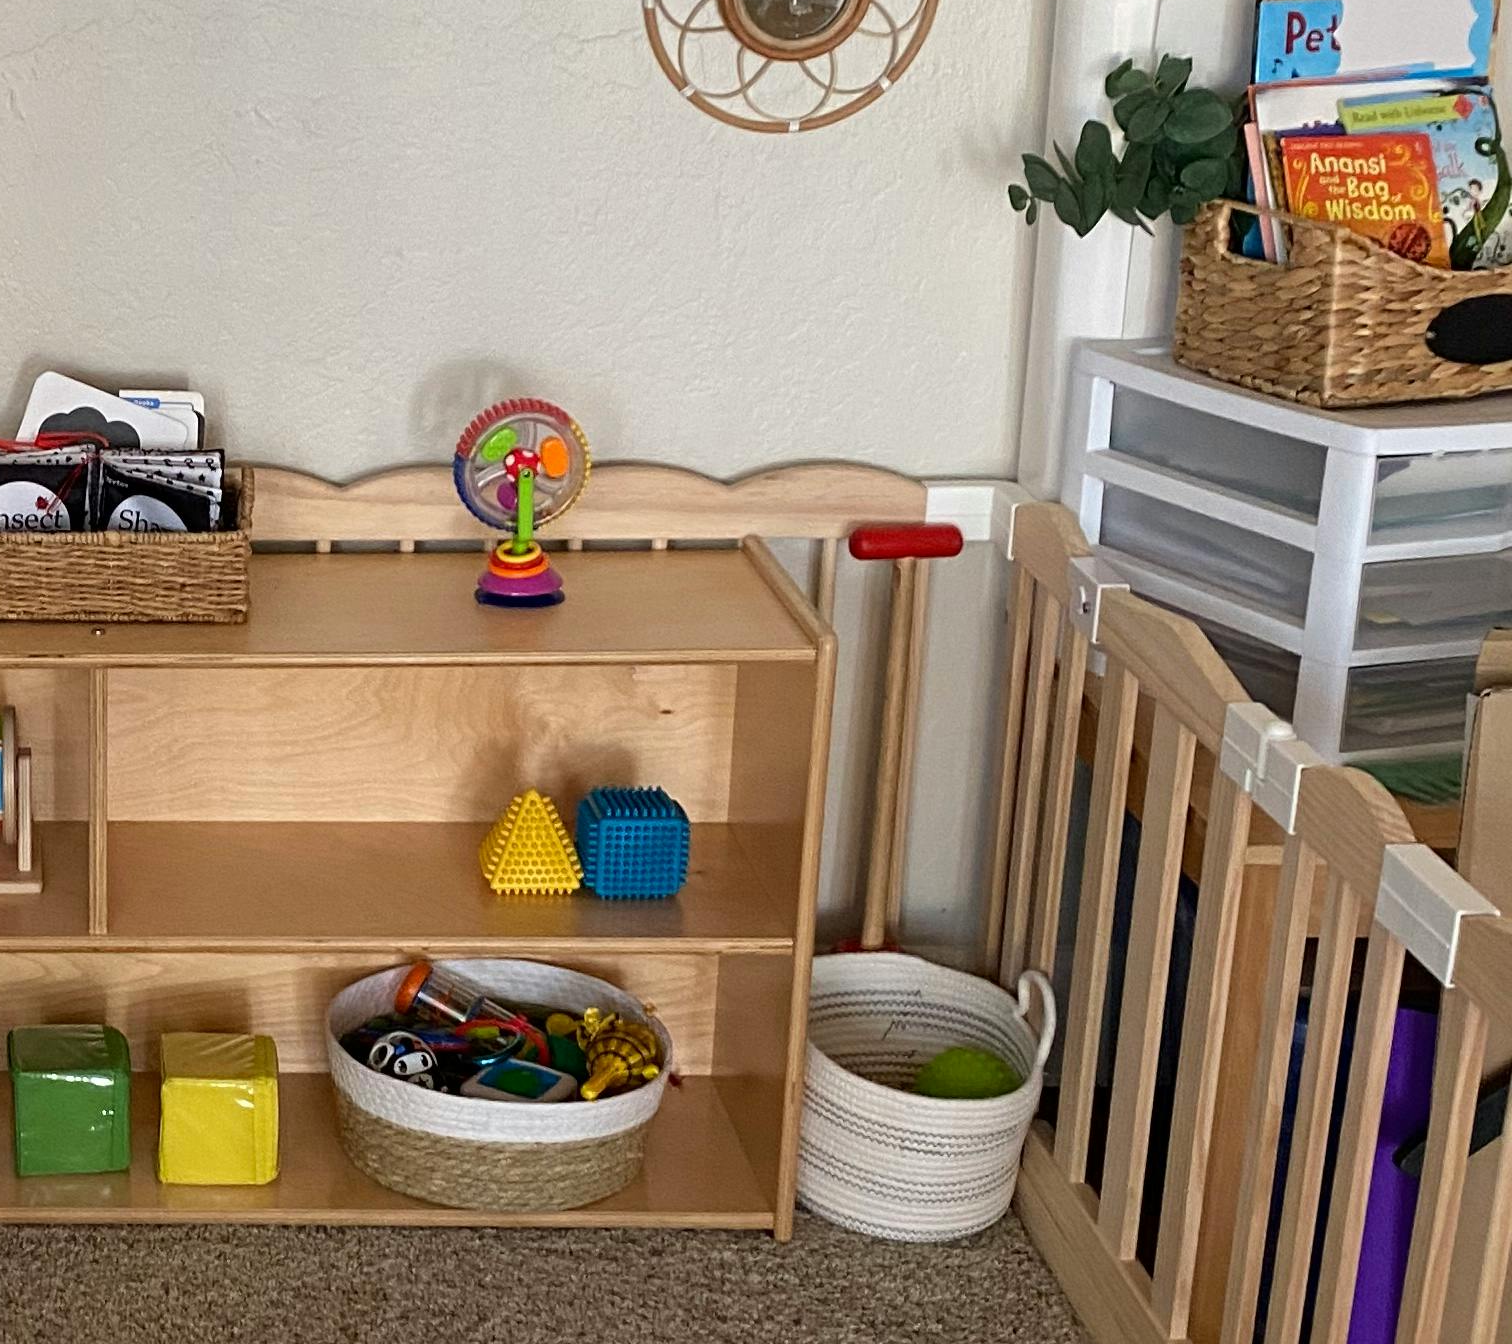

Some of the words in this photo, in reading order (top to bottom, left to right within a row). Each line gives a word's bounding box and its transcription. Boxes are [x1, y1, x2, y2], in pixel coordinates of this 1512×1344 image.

[1310, 152, 1386, 175] Anansi
[1319, 174, 1340, 185] and
[1346, 176, 1390, 201] Bag
[1325, 198, 1416, 222] Wisdom
